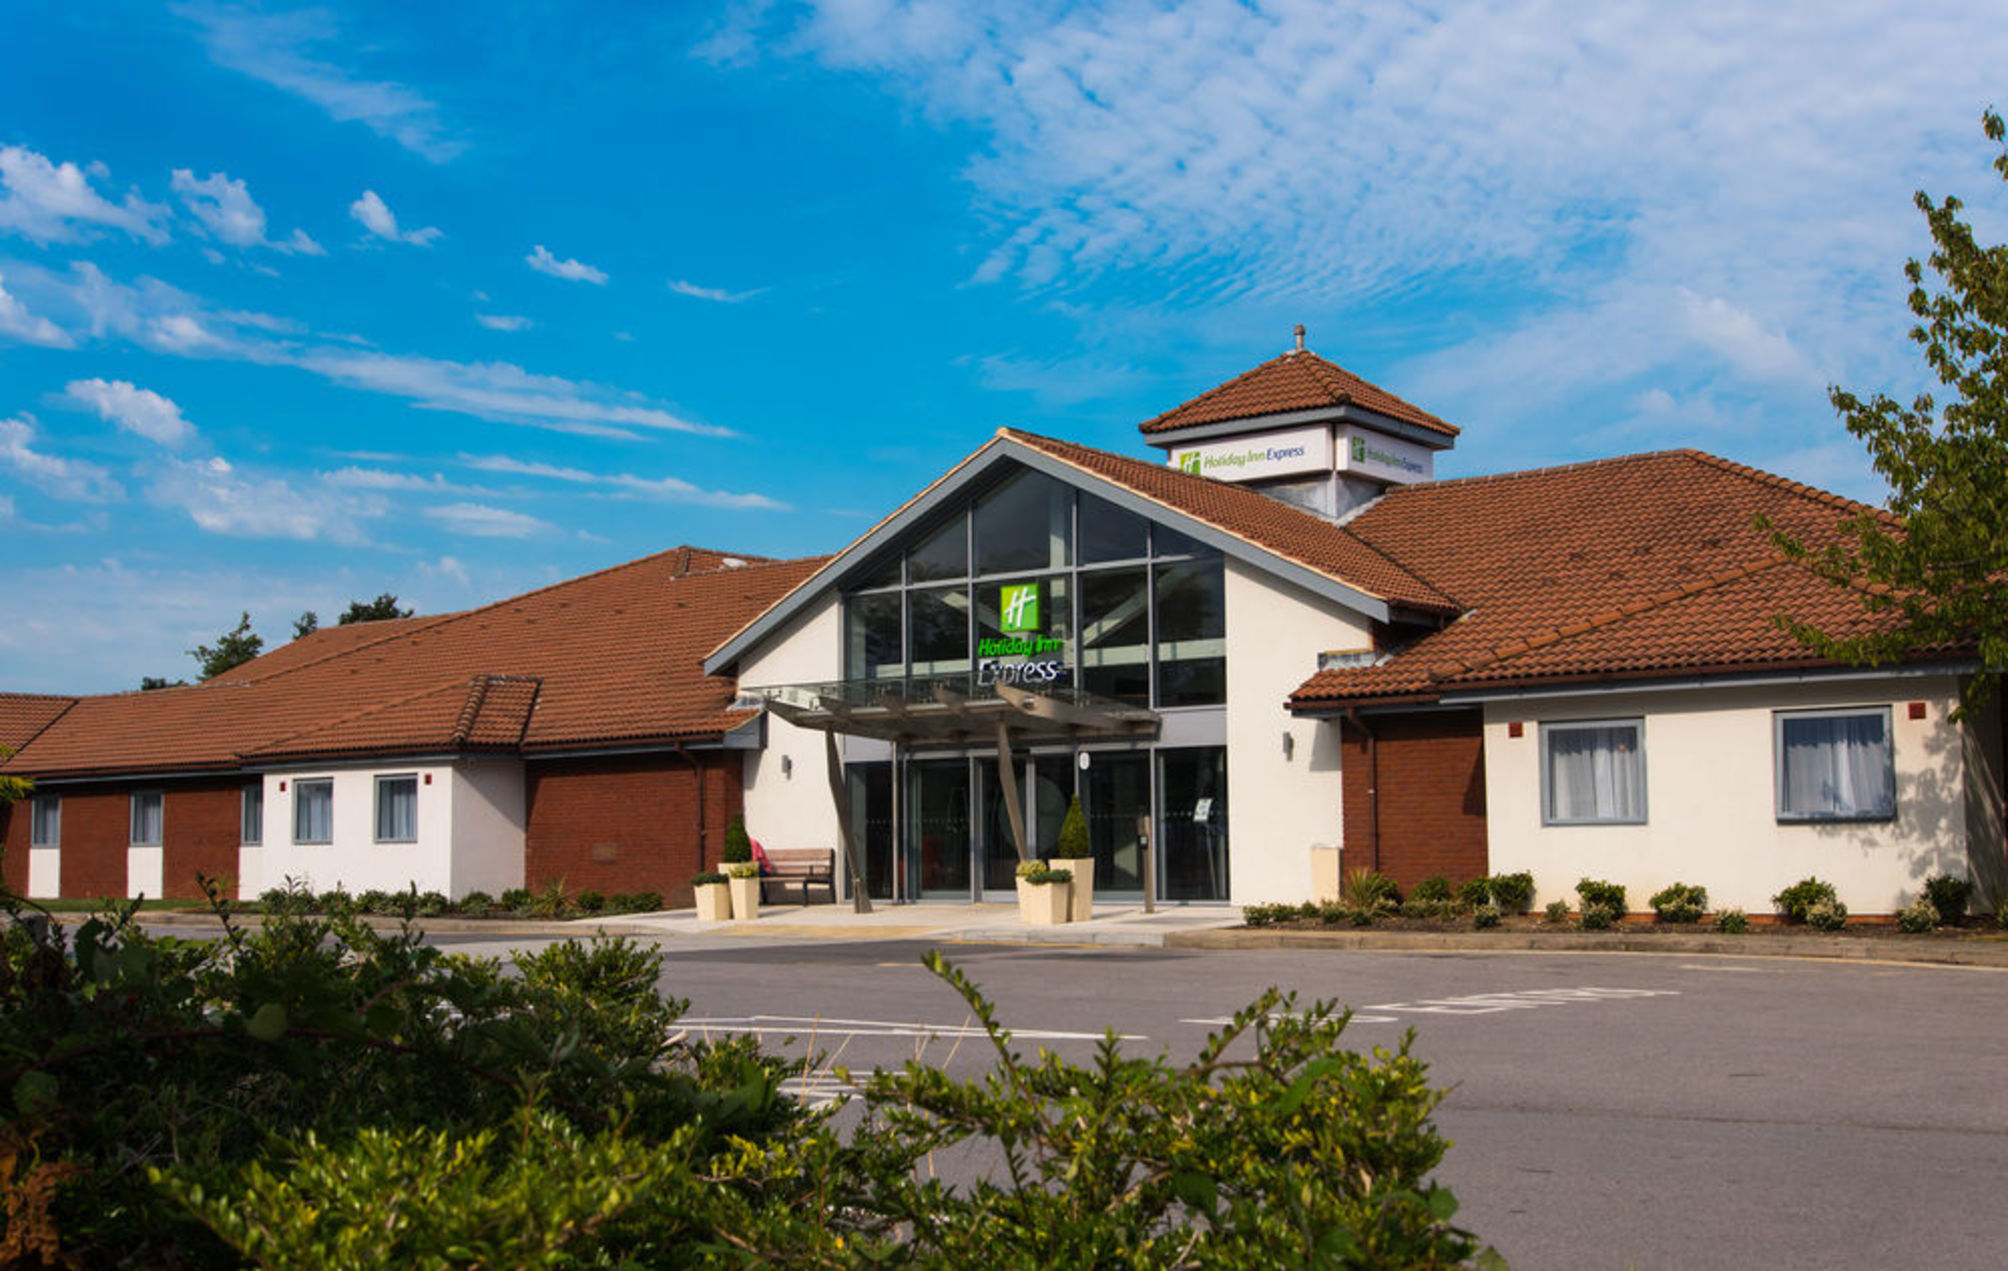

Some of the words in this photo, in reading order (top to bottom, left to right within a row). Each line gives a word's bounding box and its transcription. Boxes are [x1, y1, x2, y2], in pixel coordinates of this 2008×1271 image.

[1204, 451, 1246, 469] Holiday
[1246, 449, 1266, 463] Inn
[1266, 445, 1304, 461] Express
[979, 637, 1034, 657] Holiday
[1035, 634, 1058, 653] Inn
[977, 660, 1060, 686] Express
